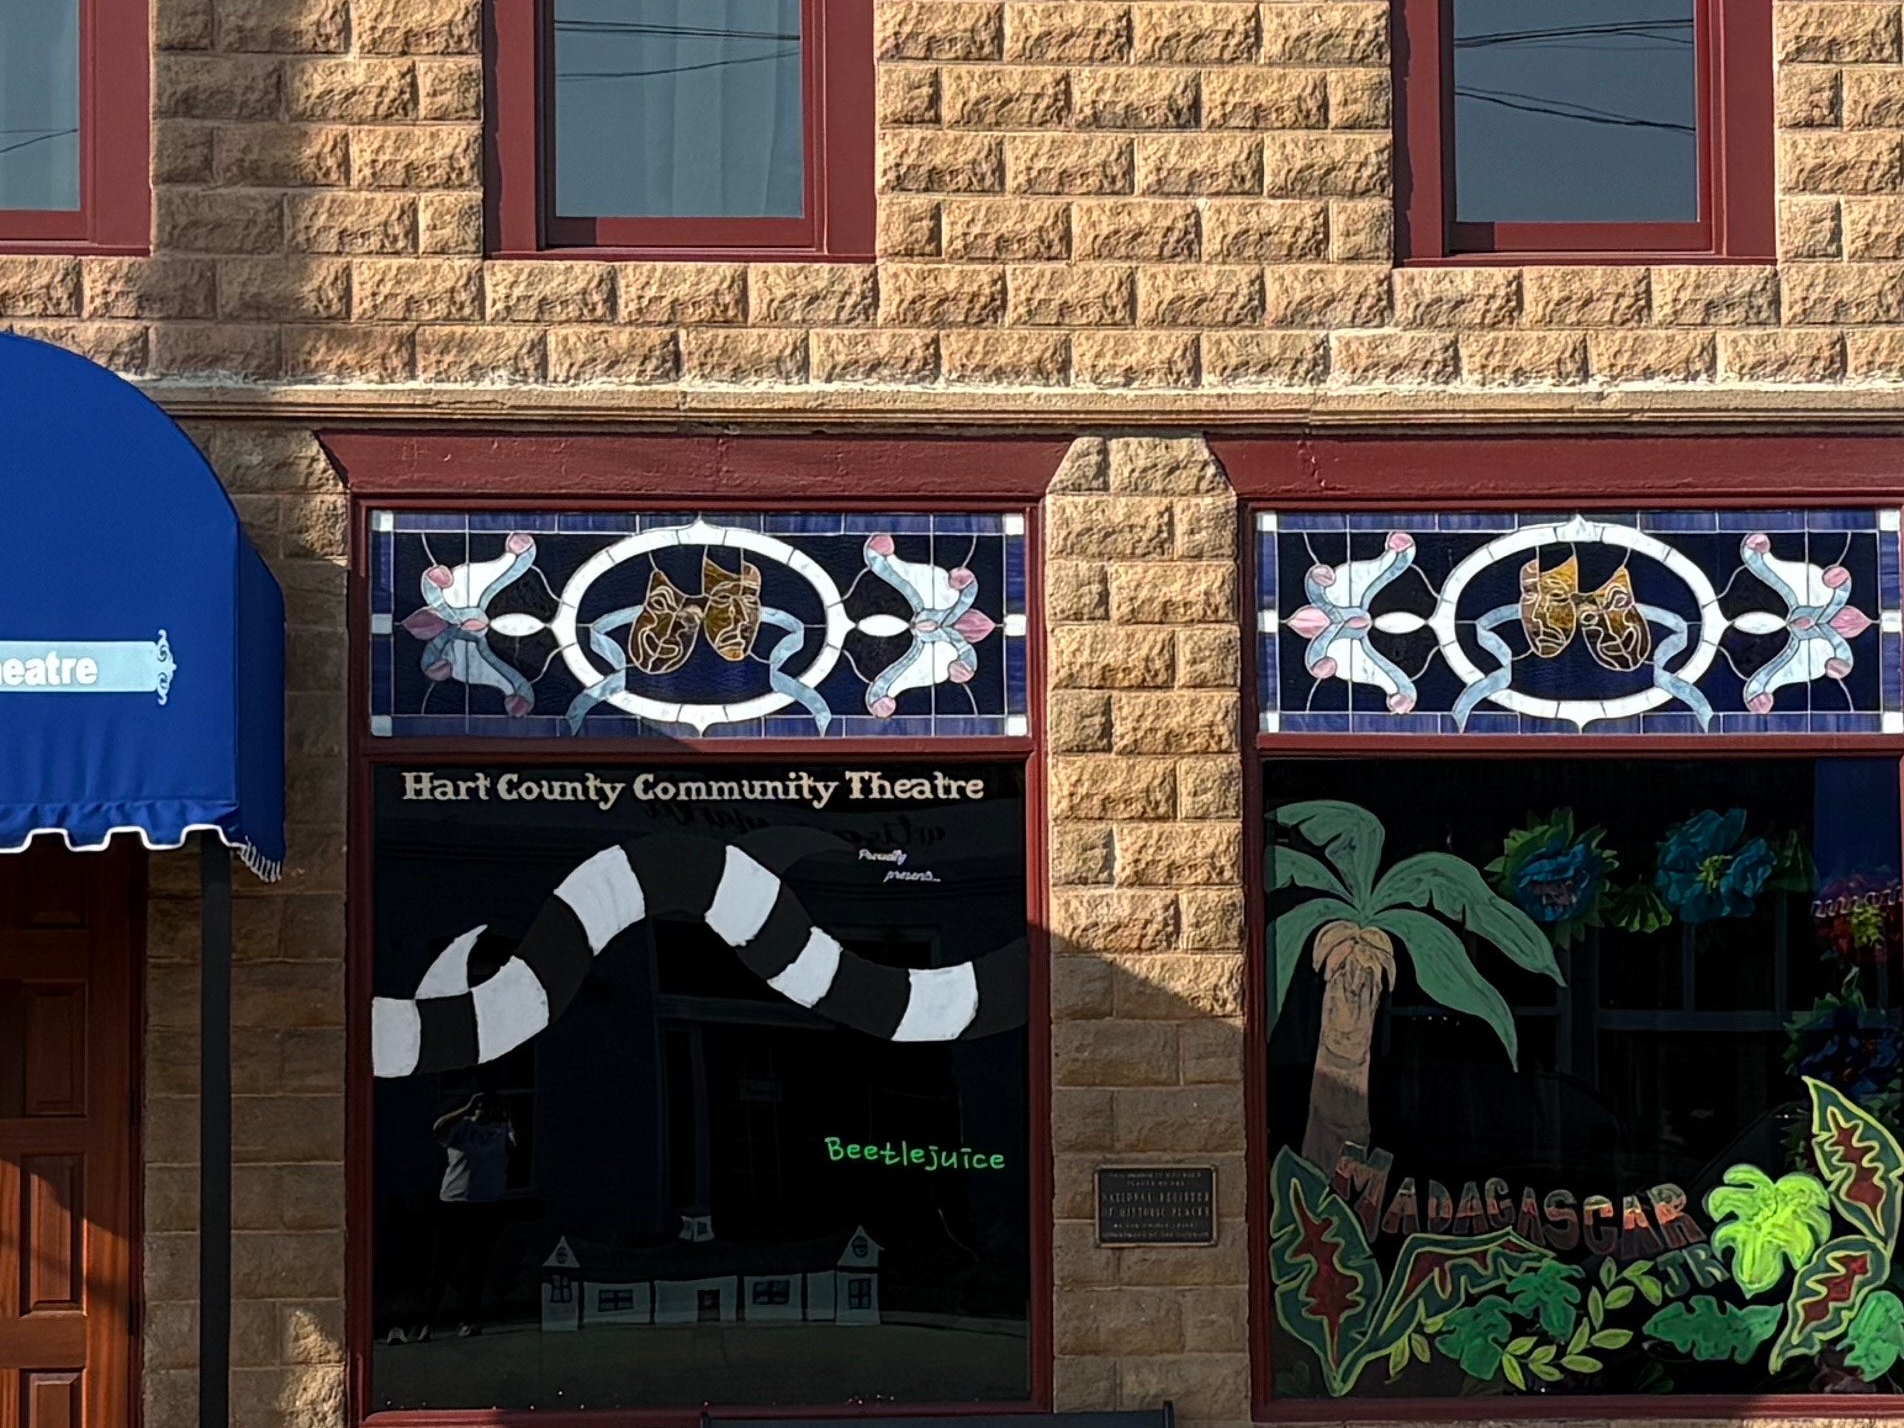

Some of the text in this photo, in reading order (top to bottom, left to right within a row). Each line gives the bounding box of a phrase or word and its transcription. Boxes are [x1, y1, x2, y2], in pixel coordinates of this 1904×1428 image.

[401, 770, 985, 811] Hart County Community Theatre
[824, 1136, 1006, 1171] Beetlejuice
[1332, 1142, 1708, 1259] MADAGASCAR
